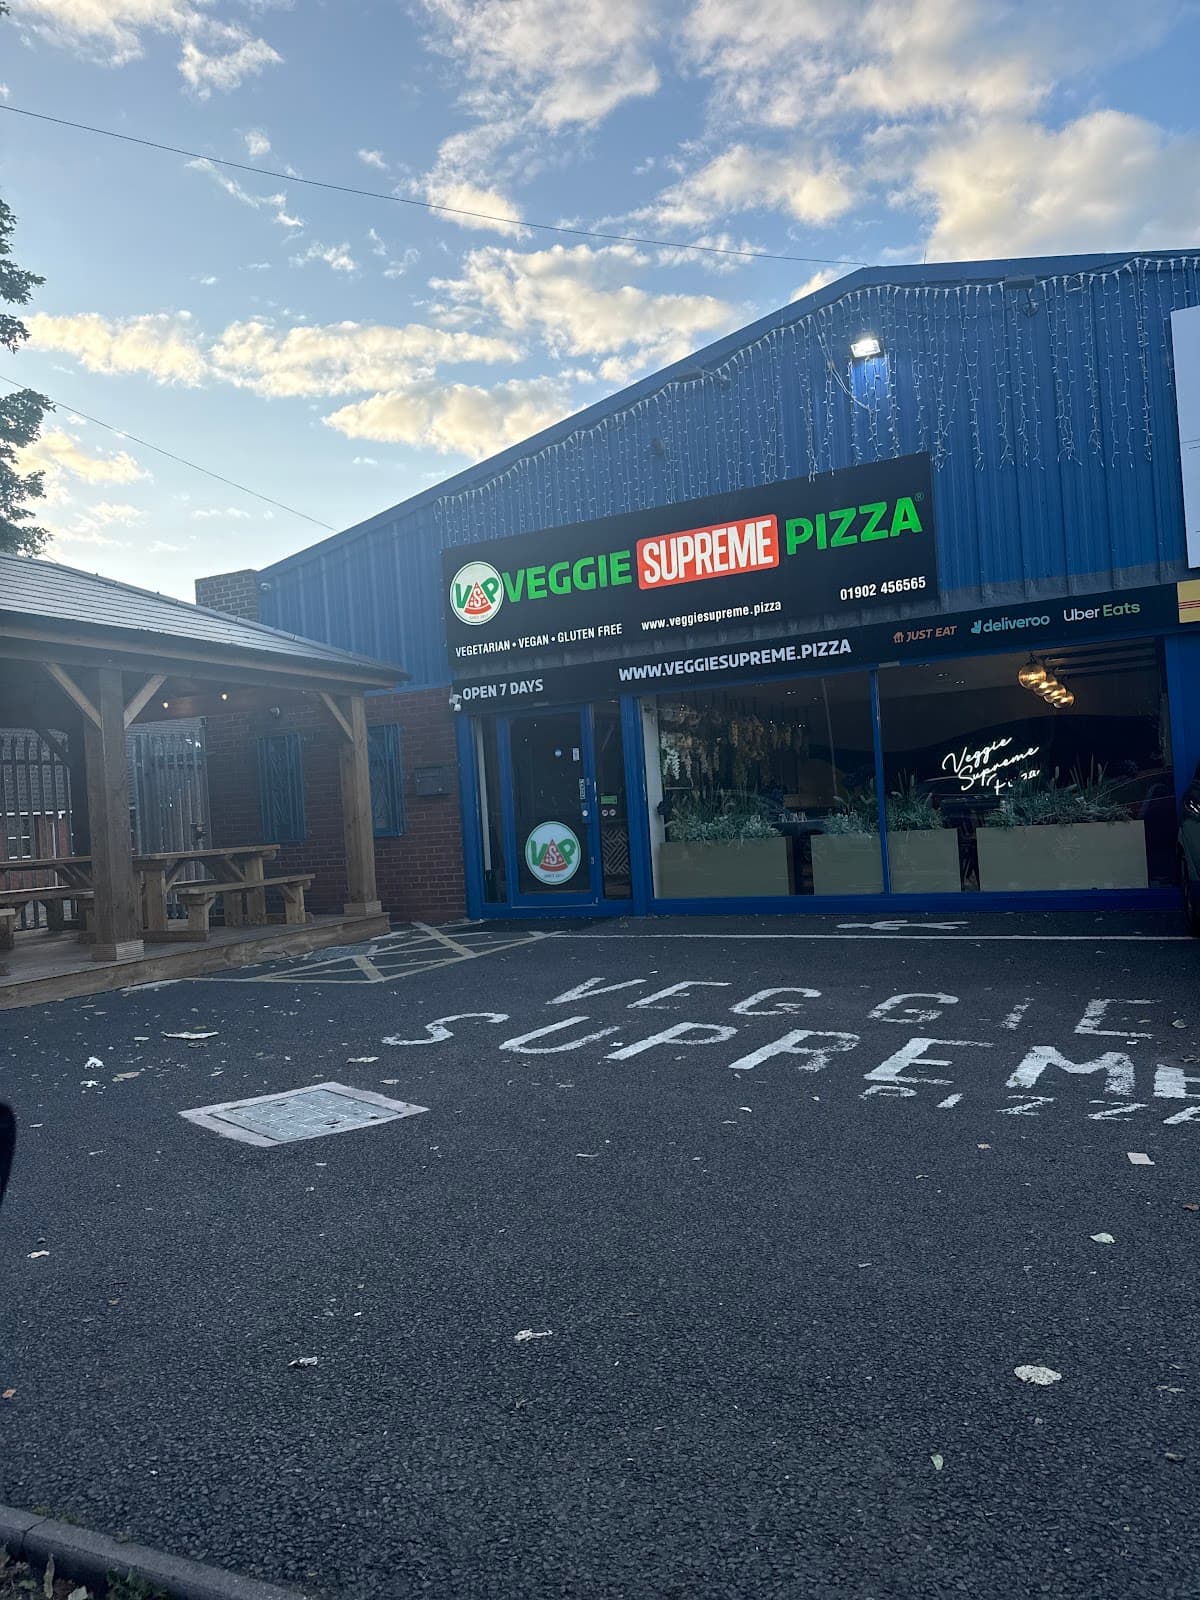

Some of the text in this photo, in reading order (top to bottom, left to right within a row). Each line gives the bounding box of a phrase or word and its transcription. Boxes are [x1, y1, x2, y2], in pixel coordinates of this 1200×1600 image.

[503, 496, 923, 603] VEGGIE SUPREME PIZZA
[839, 576, 926, 602] 01902 456565
[641, 600, 782, 631] www.veggiesupreme.pizza
[982, 613, 1051, 634] deliveroo
[1063, 602, 1141, 623] Uber Eats
[455, 622, 623, 658] VEGETARIAN VEGAN GLUTEN FREE
[905, 625, 957, 643] JUST EAT
[618, 638, 852, 682] WWW.VEGGIESUPREME.PIZZA
[462, 678, 544, 701] OPEN 7 DAYS
[941, 736, 1013, 774] Veggie
[957, 746, 1040, 791] Supreme
[545, 976, 1162, 1039] VEGGIE
